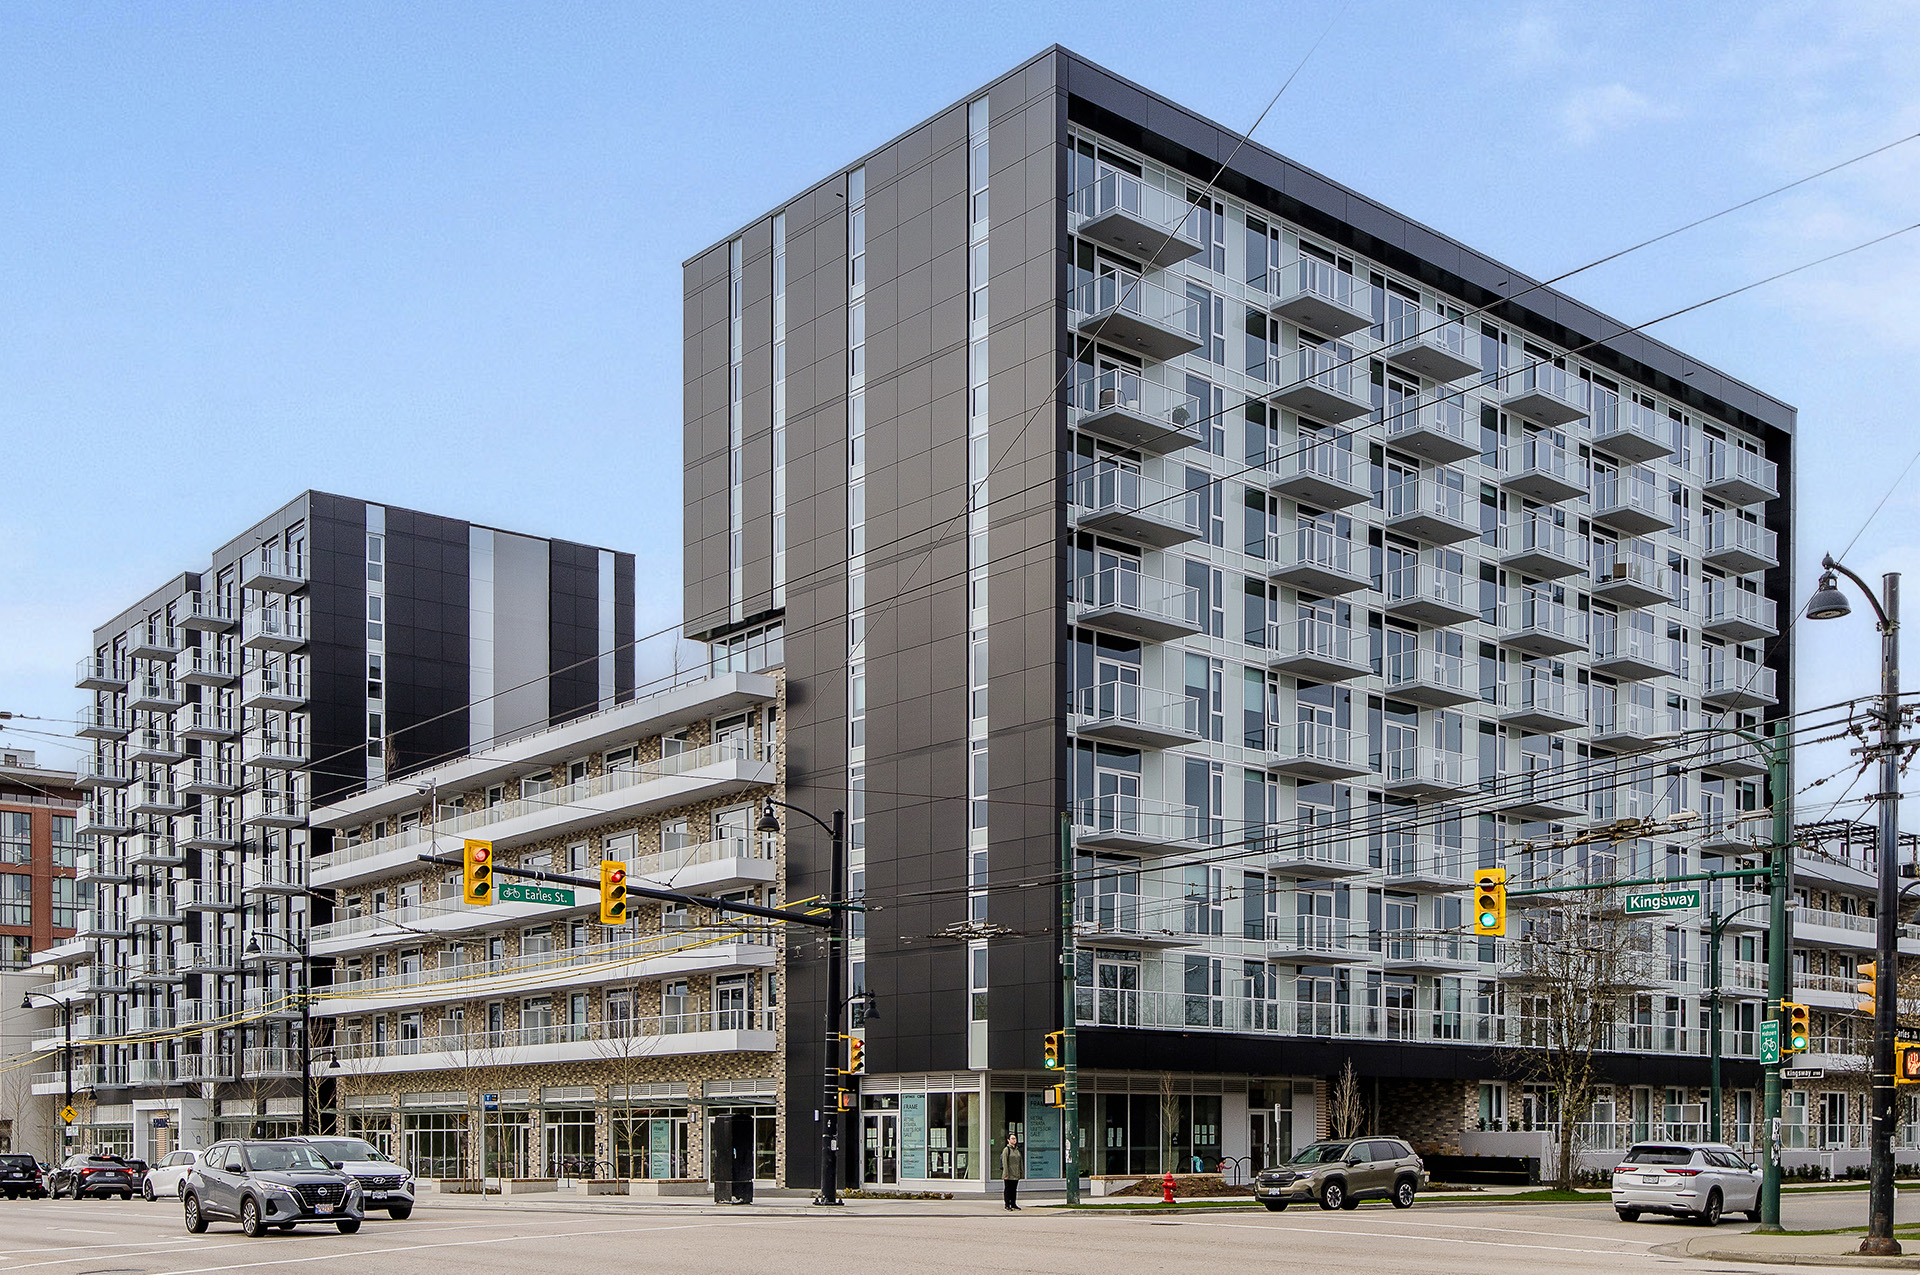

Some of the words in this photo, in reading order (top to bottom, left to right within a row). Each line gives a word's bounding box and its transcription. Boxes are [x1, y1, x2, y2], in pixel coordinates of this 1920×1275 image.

[525, 889, 552, 902] Earles
[555, 892, 568, 903] St.
[1630, 894, 1695, 910] Kingsway
